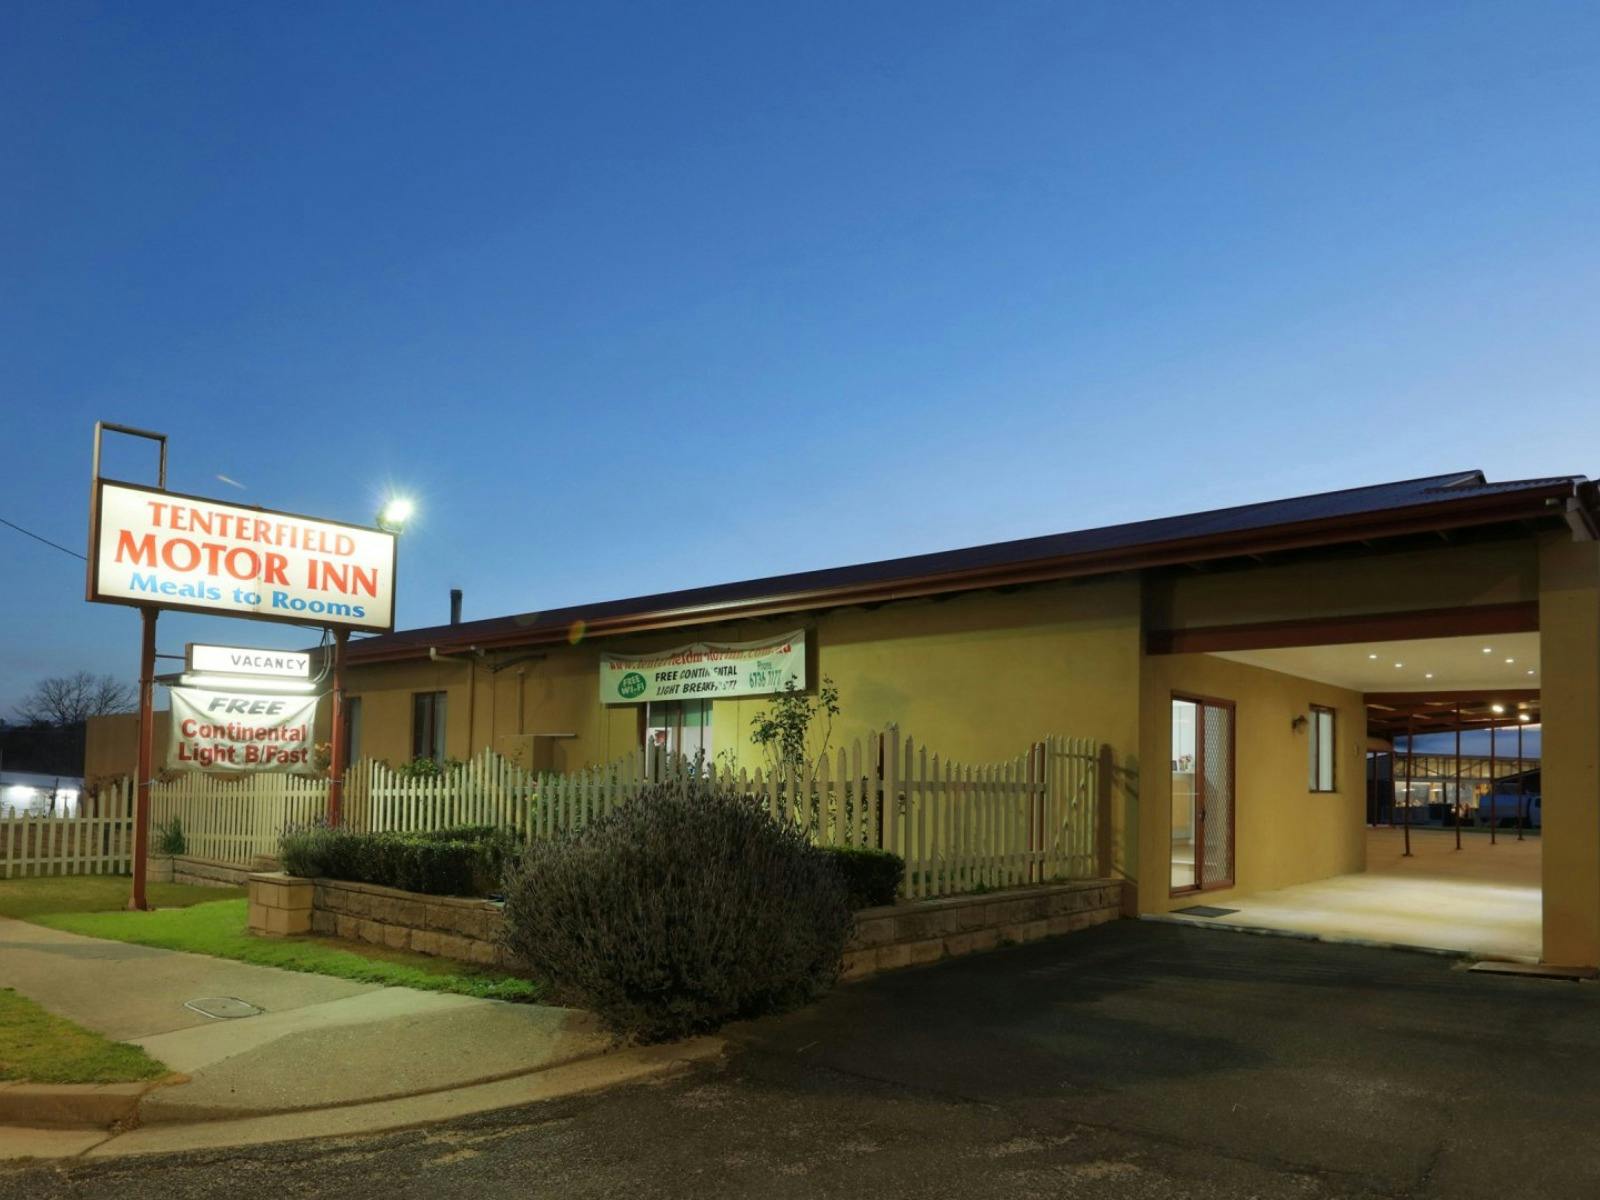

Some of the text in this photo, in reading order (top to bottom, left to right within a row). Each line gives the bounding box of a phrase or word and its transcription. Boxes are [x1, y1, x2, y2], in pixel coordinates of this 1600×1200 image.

[148, 501, 356, 557] TENTERFIELD
[114, 530, 379, 599] MOTOR INN
[129, 572, 366, 619] Meals to Rooms
[231, 654, 307, 670] VACANCY
[622, 674, 641, 687] FREE
[655, 671, 679, 682] FREE
[656, 684, 680, 696] LIGHT
[208, 697, 286, 715] FREE
[182, 719, 306, 741] Continental
[178, 742, 308, 766] Light B/Fast
